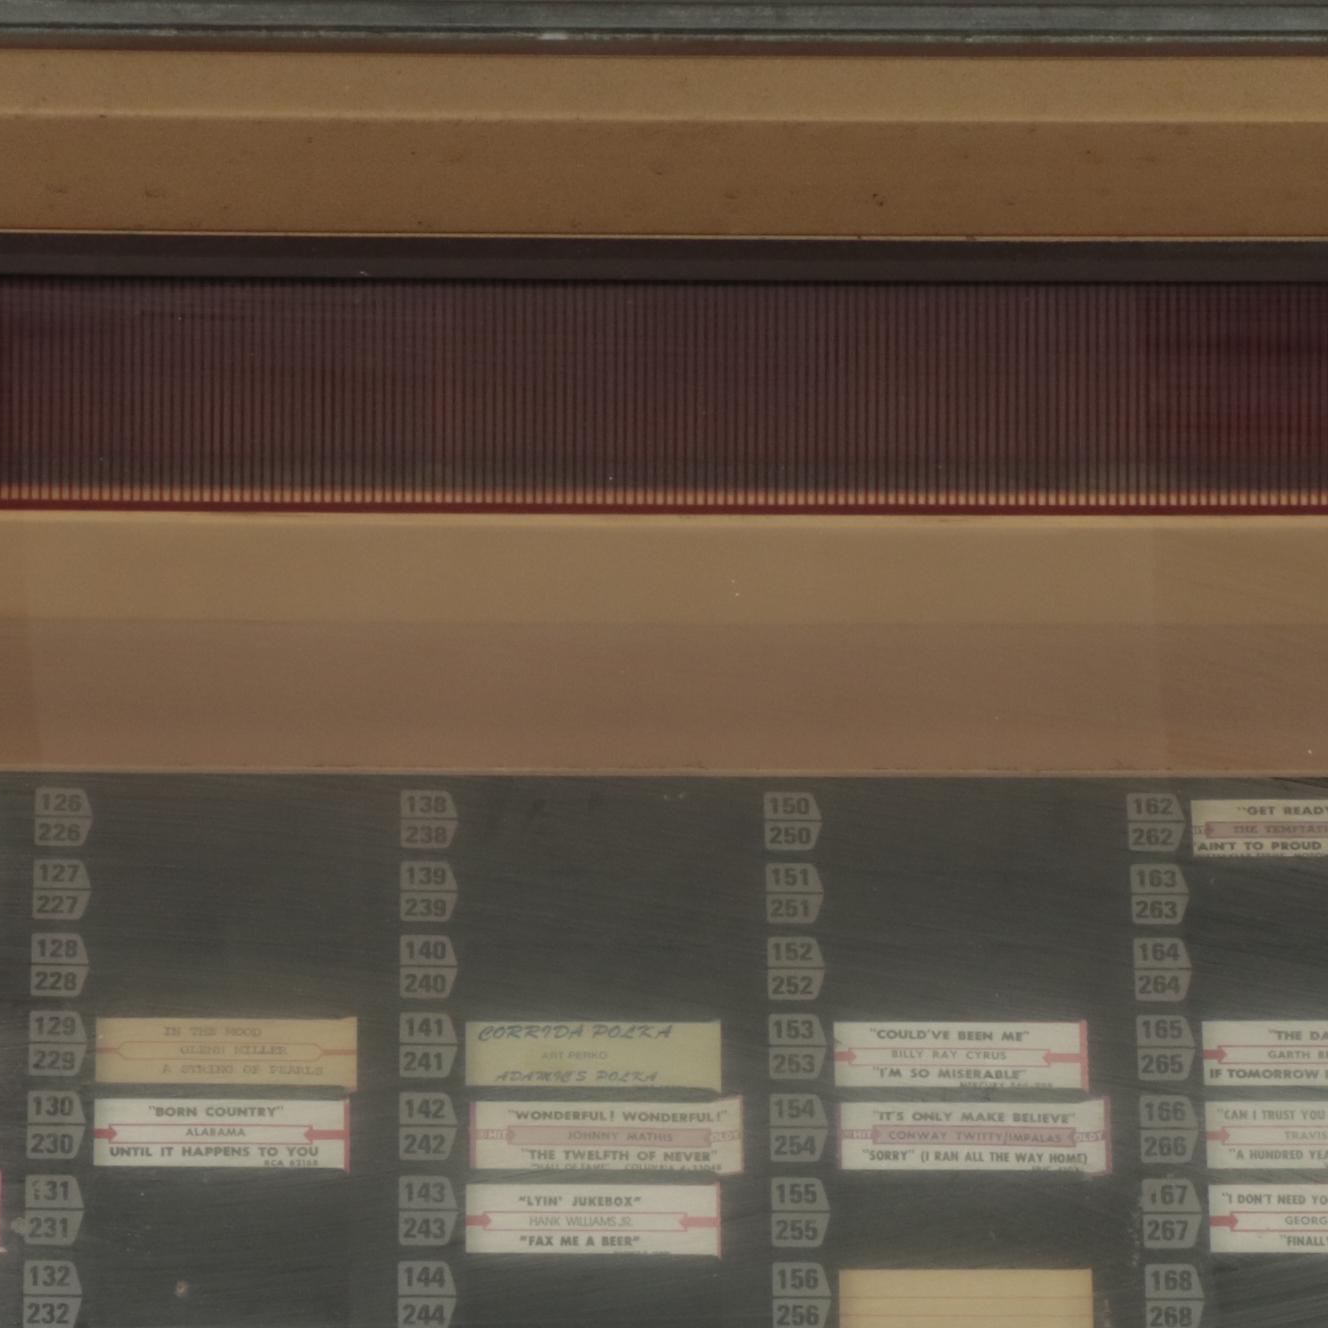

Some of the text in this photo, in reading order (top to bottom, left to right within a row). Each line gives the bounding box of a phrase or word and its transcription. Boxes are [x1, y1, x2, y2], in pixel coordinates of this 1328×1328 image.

[773, 1021, 814, 1039] 153
[148, 1105, 284, 1118] "BORN COUNTRY"
[405, 1100, 444, 1118] 142
[185, 1128, 246, 1137] ALABAMA
[568, 1131, 673, 1142] JOHNNY MATHIS
[110, 1146, 319, 1158] UNTIL IT HAPPENS TO YOU
[27, 1304, 69, 1324] 232
